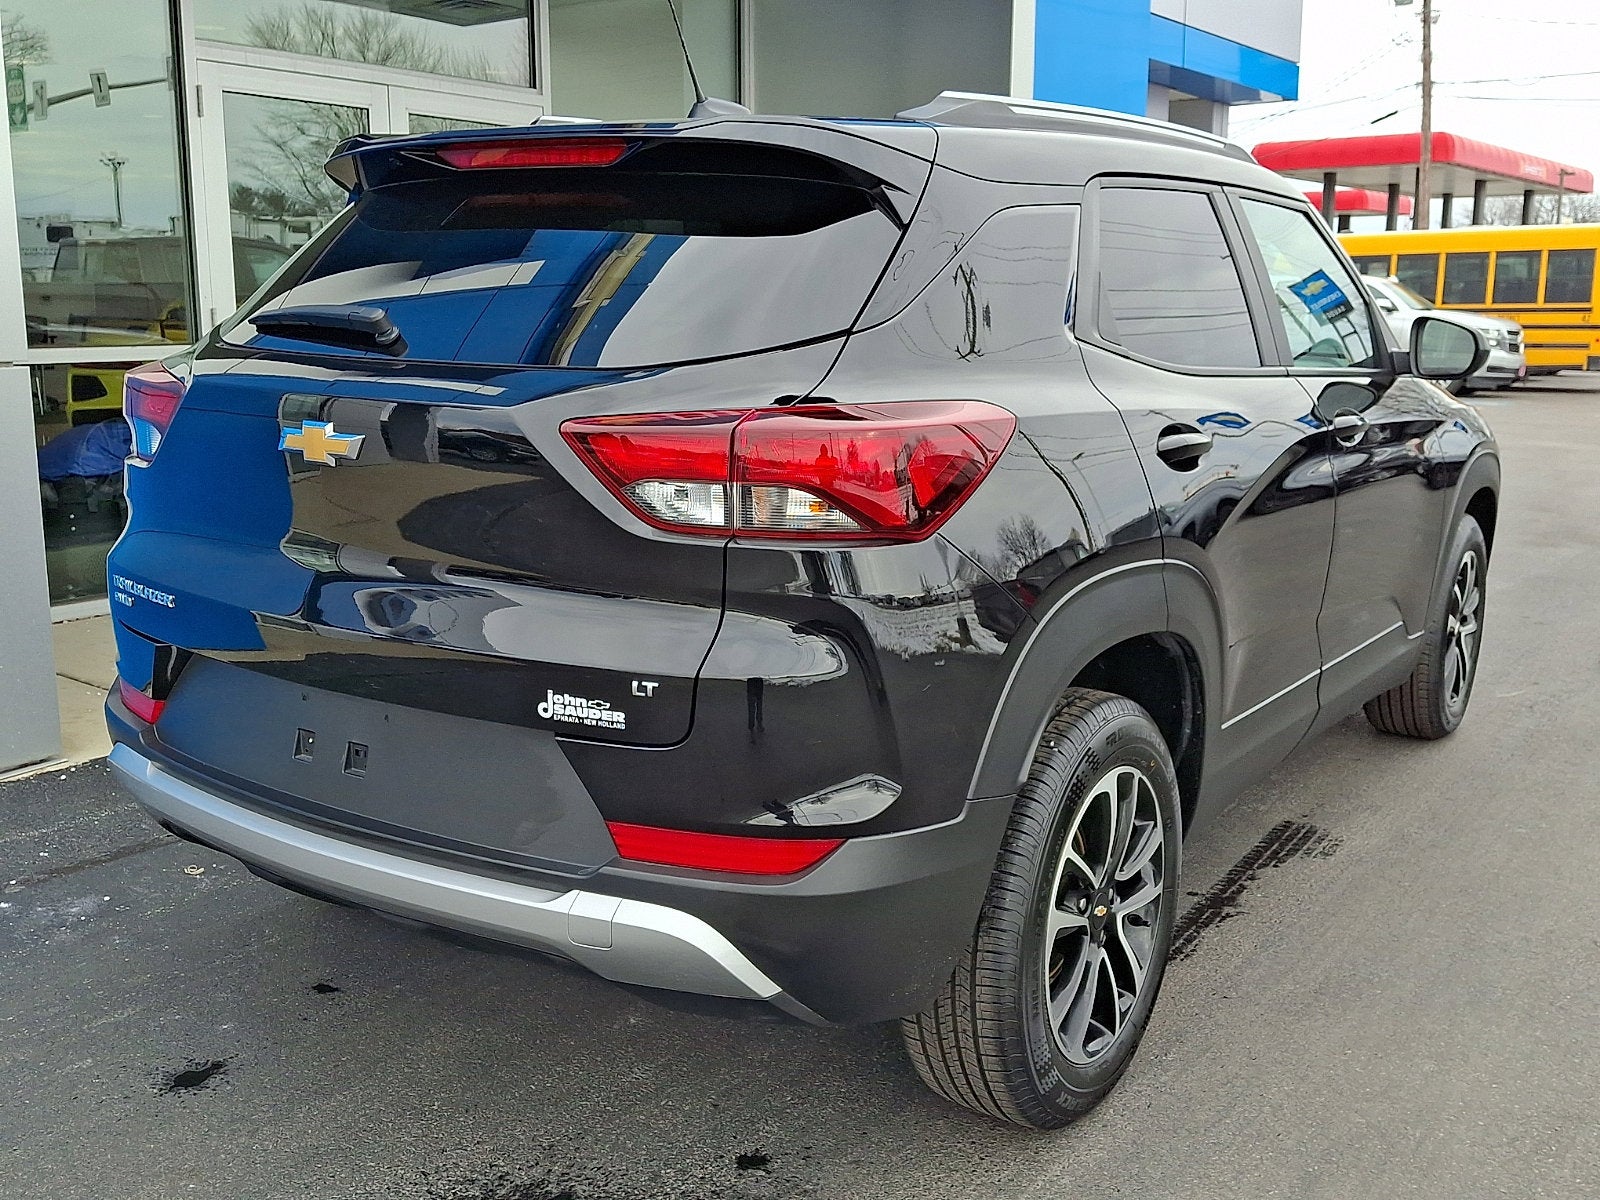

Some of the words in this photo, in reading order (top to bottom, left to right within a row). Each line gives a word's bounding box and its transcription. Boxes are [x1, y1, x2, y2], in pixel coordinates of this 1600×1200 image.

[631, 680, 659, 698] LT
[553, 704, 626, 723] SAUDER
[554, 713, 580, 724] EPHRATA
[583, 718, 597, 727] NEW
[598, 720, 626, 730] HOLLAND
